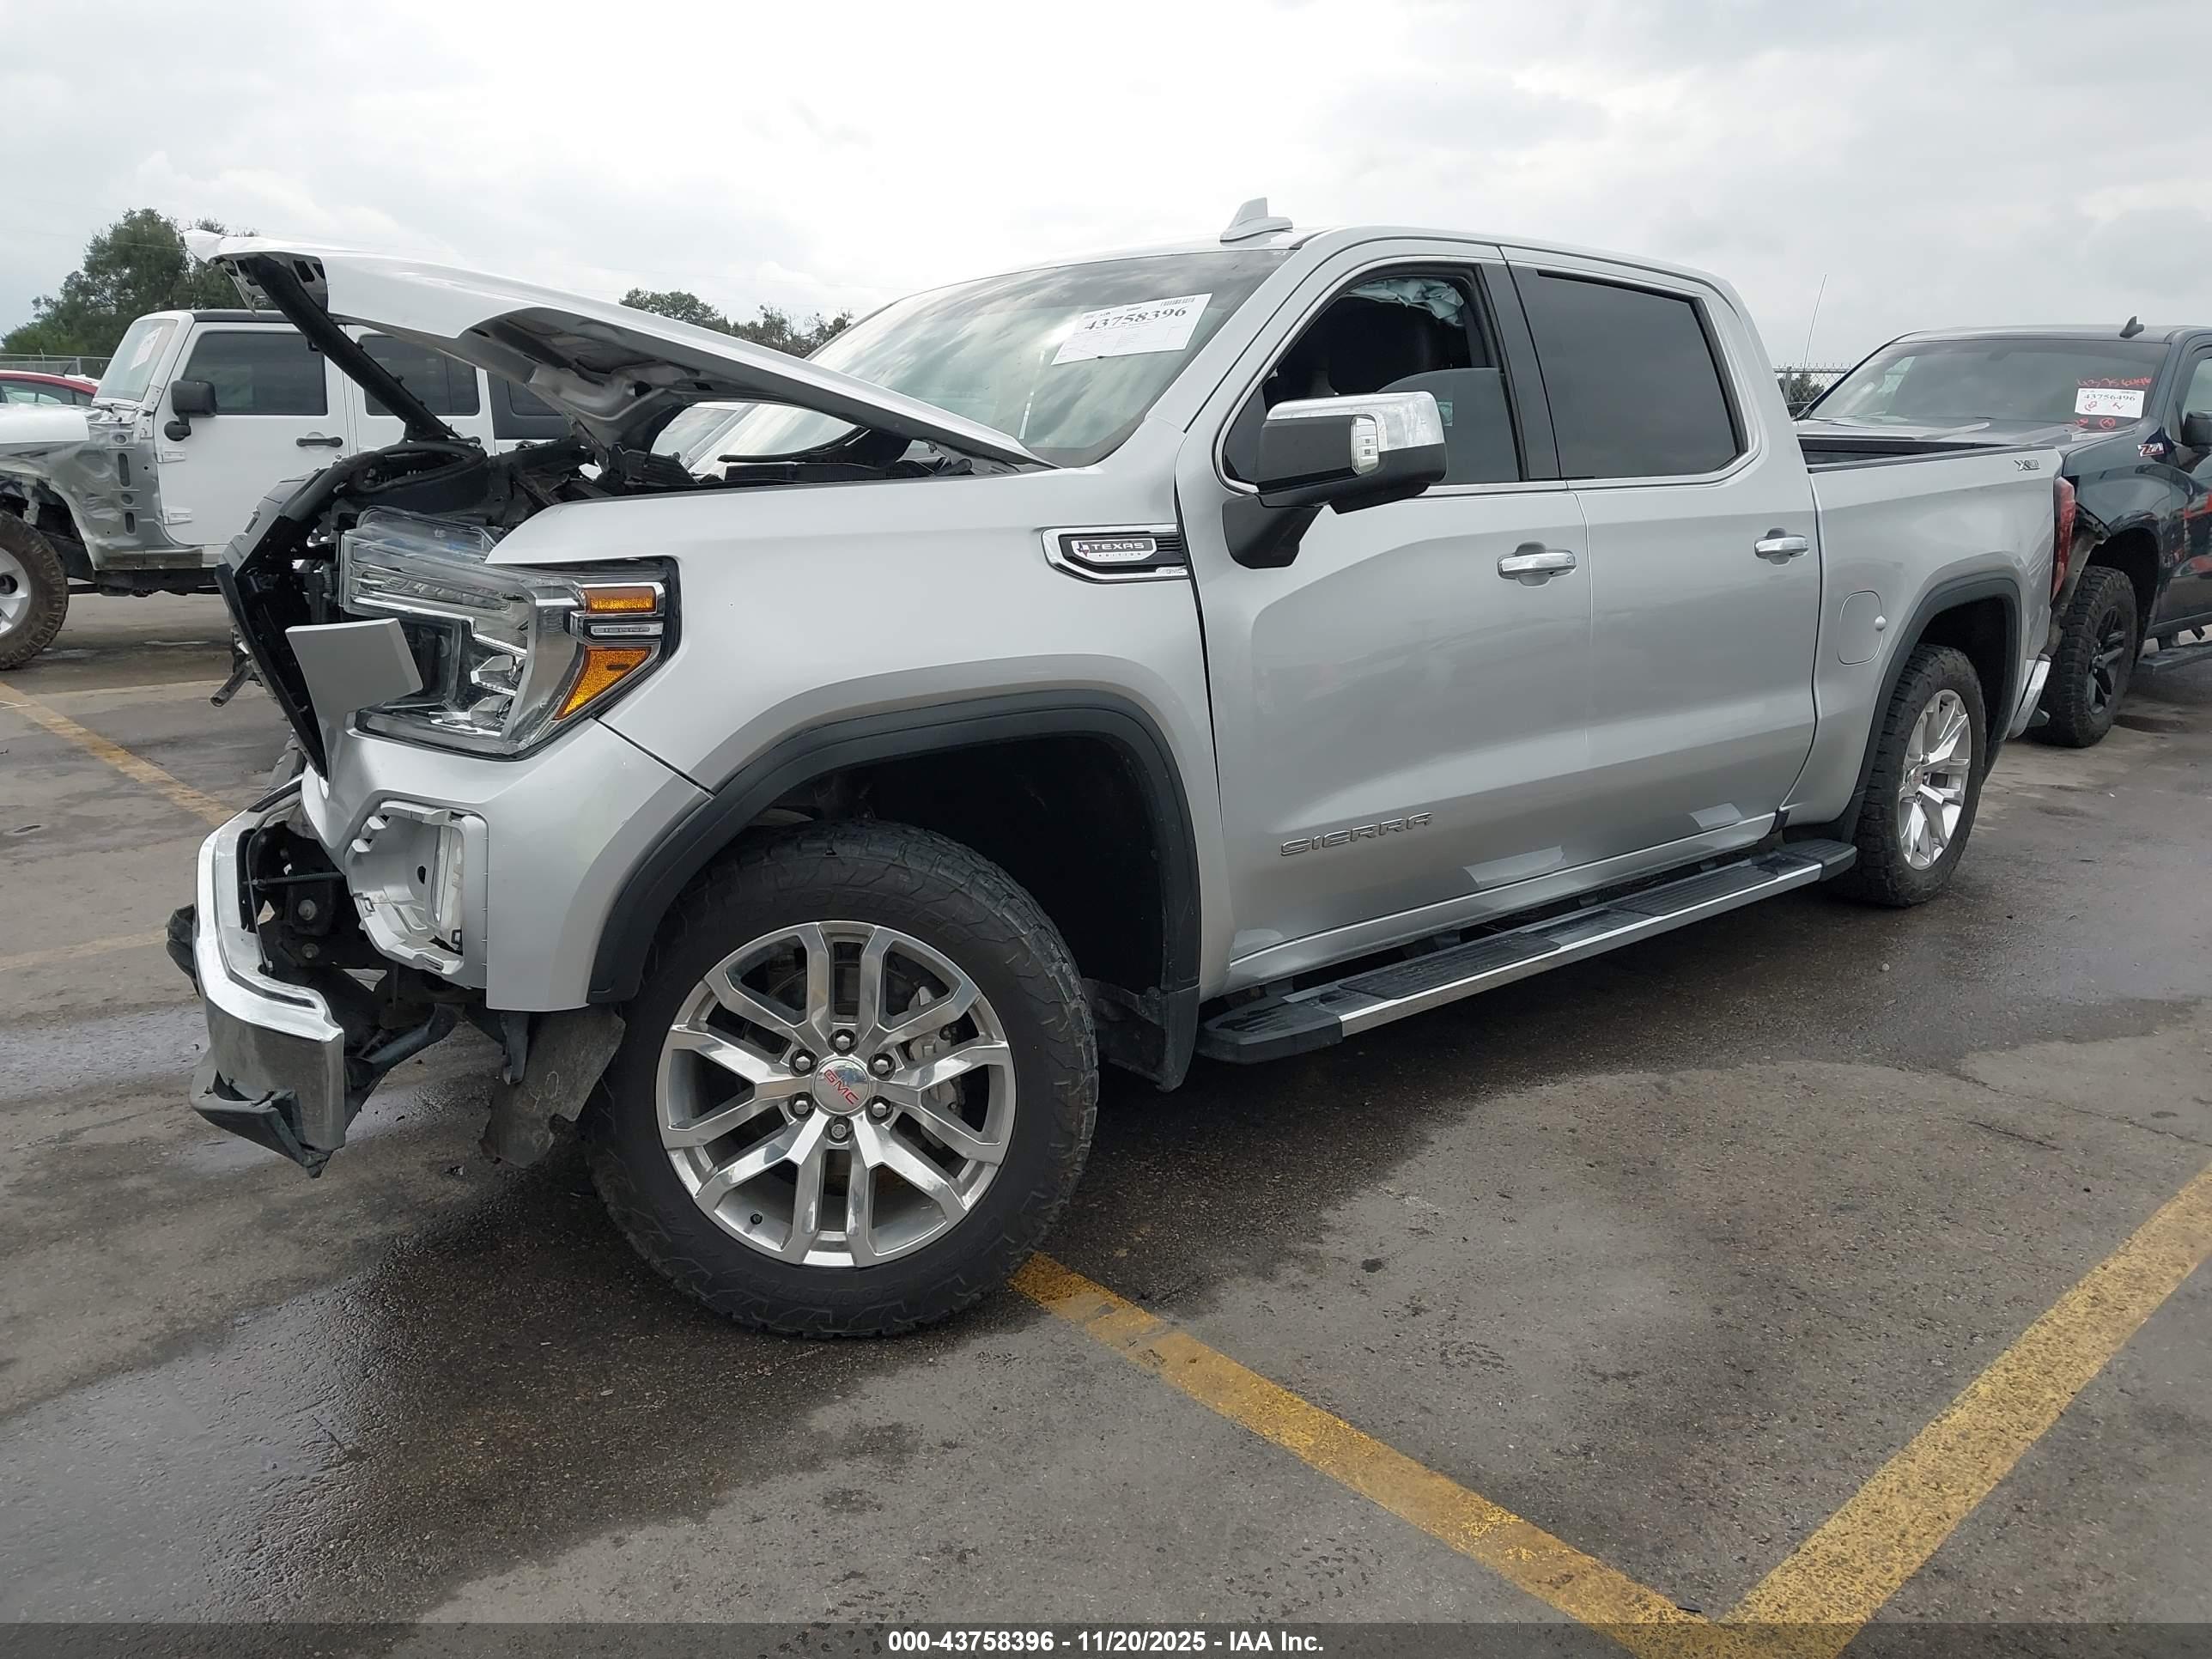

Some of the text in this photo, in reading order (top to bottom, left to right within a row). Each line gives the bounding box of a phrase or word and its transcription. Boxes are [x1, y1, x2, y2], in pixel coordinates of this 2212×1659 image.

[1085, 307, 1188, 331] 43758396
[1091, 542, 1145, 550] TEXAS
[1280, 811, 1434, 857] SIERRA
[823, 1068, 860, 1105] GMC
